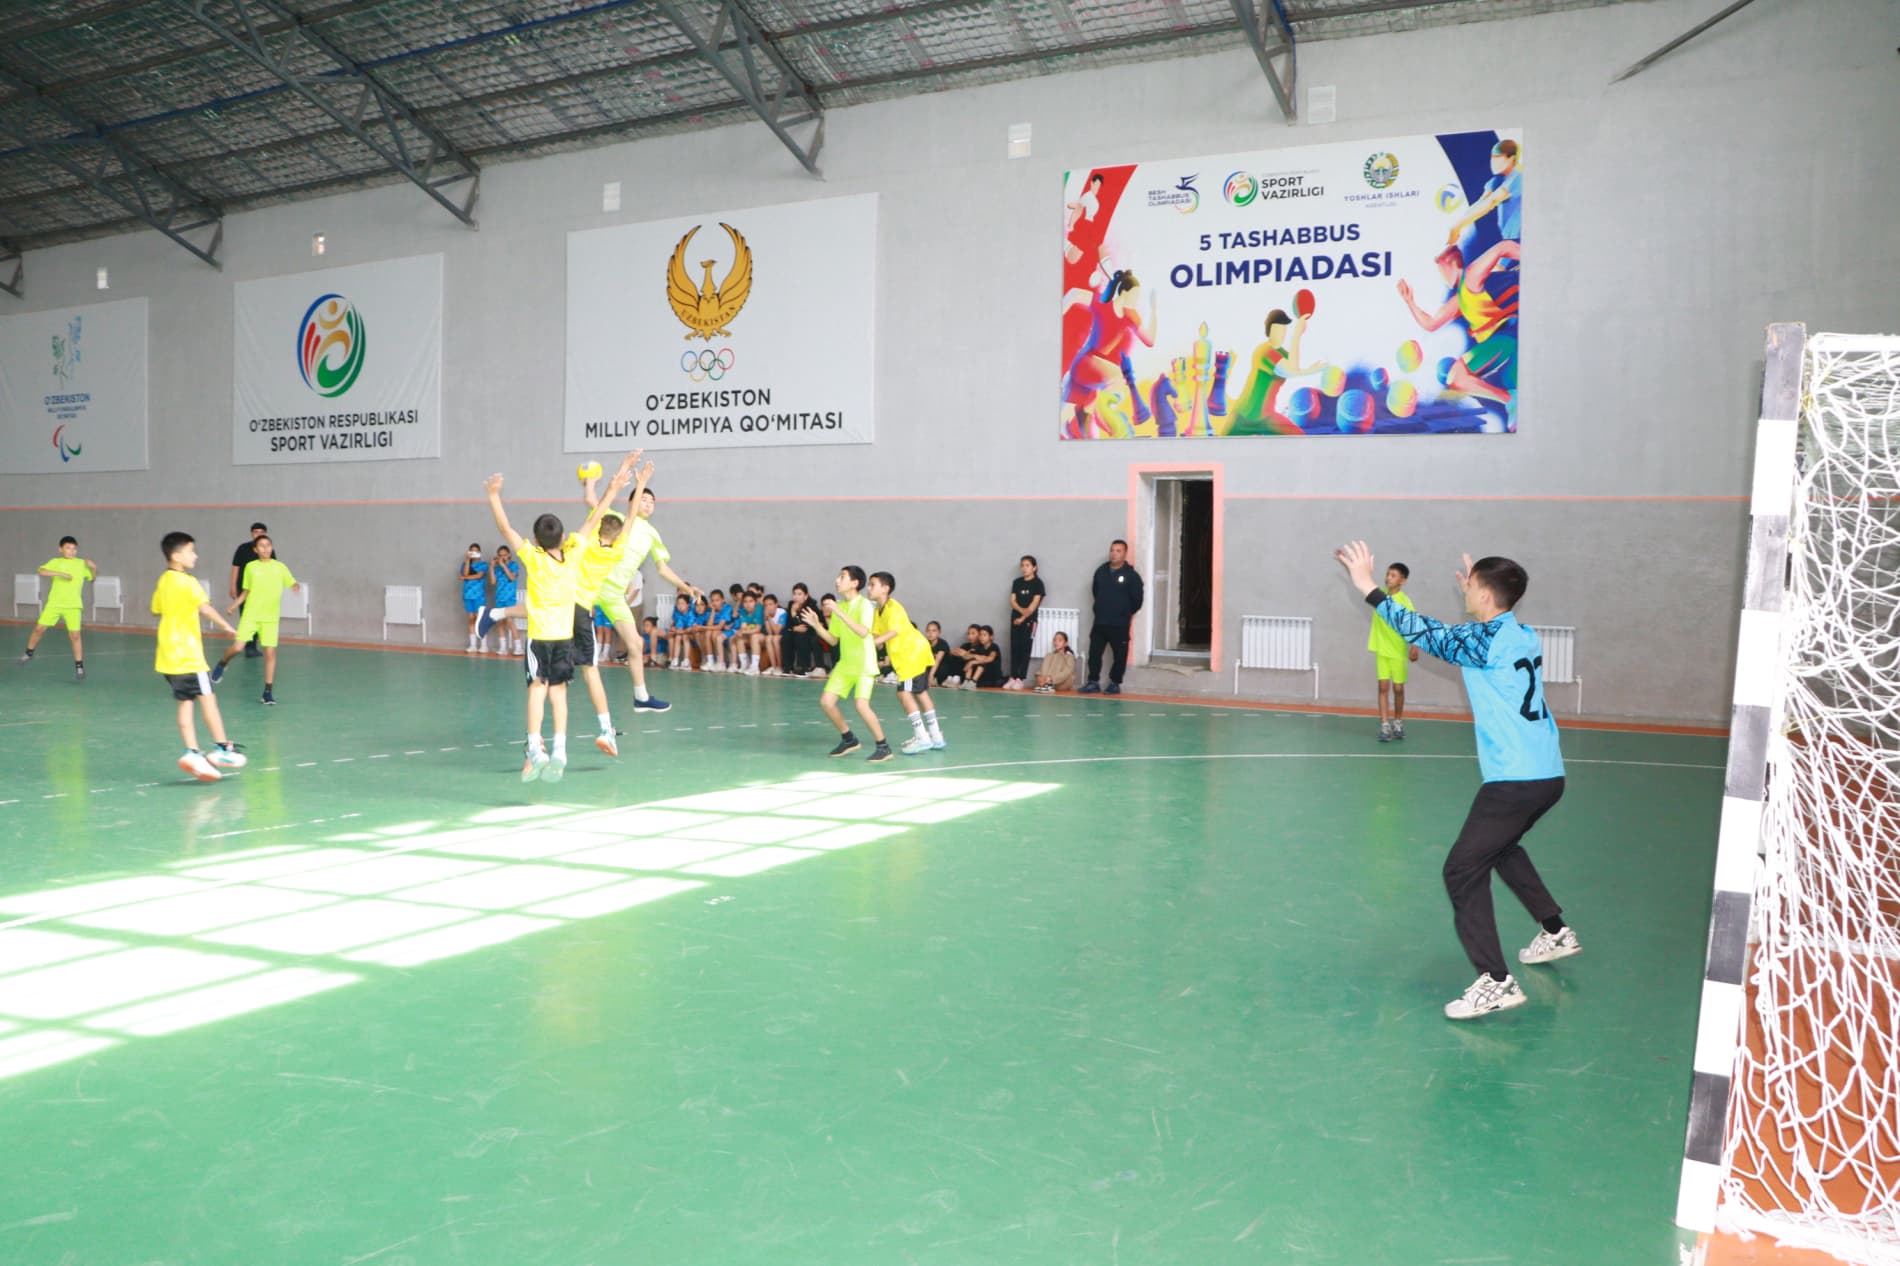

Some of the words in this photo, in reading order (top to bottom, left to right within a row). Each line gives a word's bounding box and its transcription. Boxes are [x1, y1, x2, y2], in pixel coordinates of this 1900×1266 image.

[1261, 176, 1304, 189] SPORT
[1261, 186, 1324, 200] VAZIRLIGI
[1344, 193, 1383, 202] YOSHLAR
[1386, 190, 1420, 199] ISHLARI
[1200, 234, 1212, 251] 5
[1218, 223, 1361, 250] TASHABBUS
[1170, 251, 1392, 289] OLIMPIADASI
[646, 388, 771, 411] O‘ZBEKISTON
[249, 415, 326, 432] O‘ZBEKISTON
[329, 409, 419, 428] RESPUBLIKASI
[585, 420, 641, 438] MILLIY
[646, 416, 733, 436] OLIMPIYA
[739, 411, 843, 432] QO‘MITASI
[270, 434, 316, 452] SPORT
[320, 430, 394, 450] VAZIRLIGI
